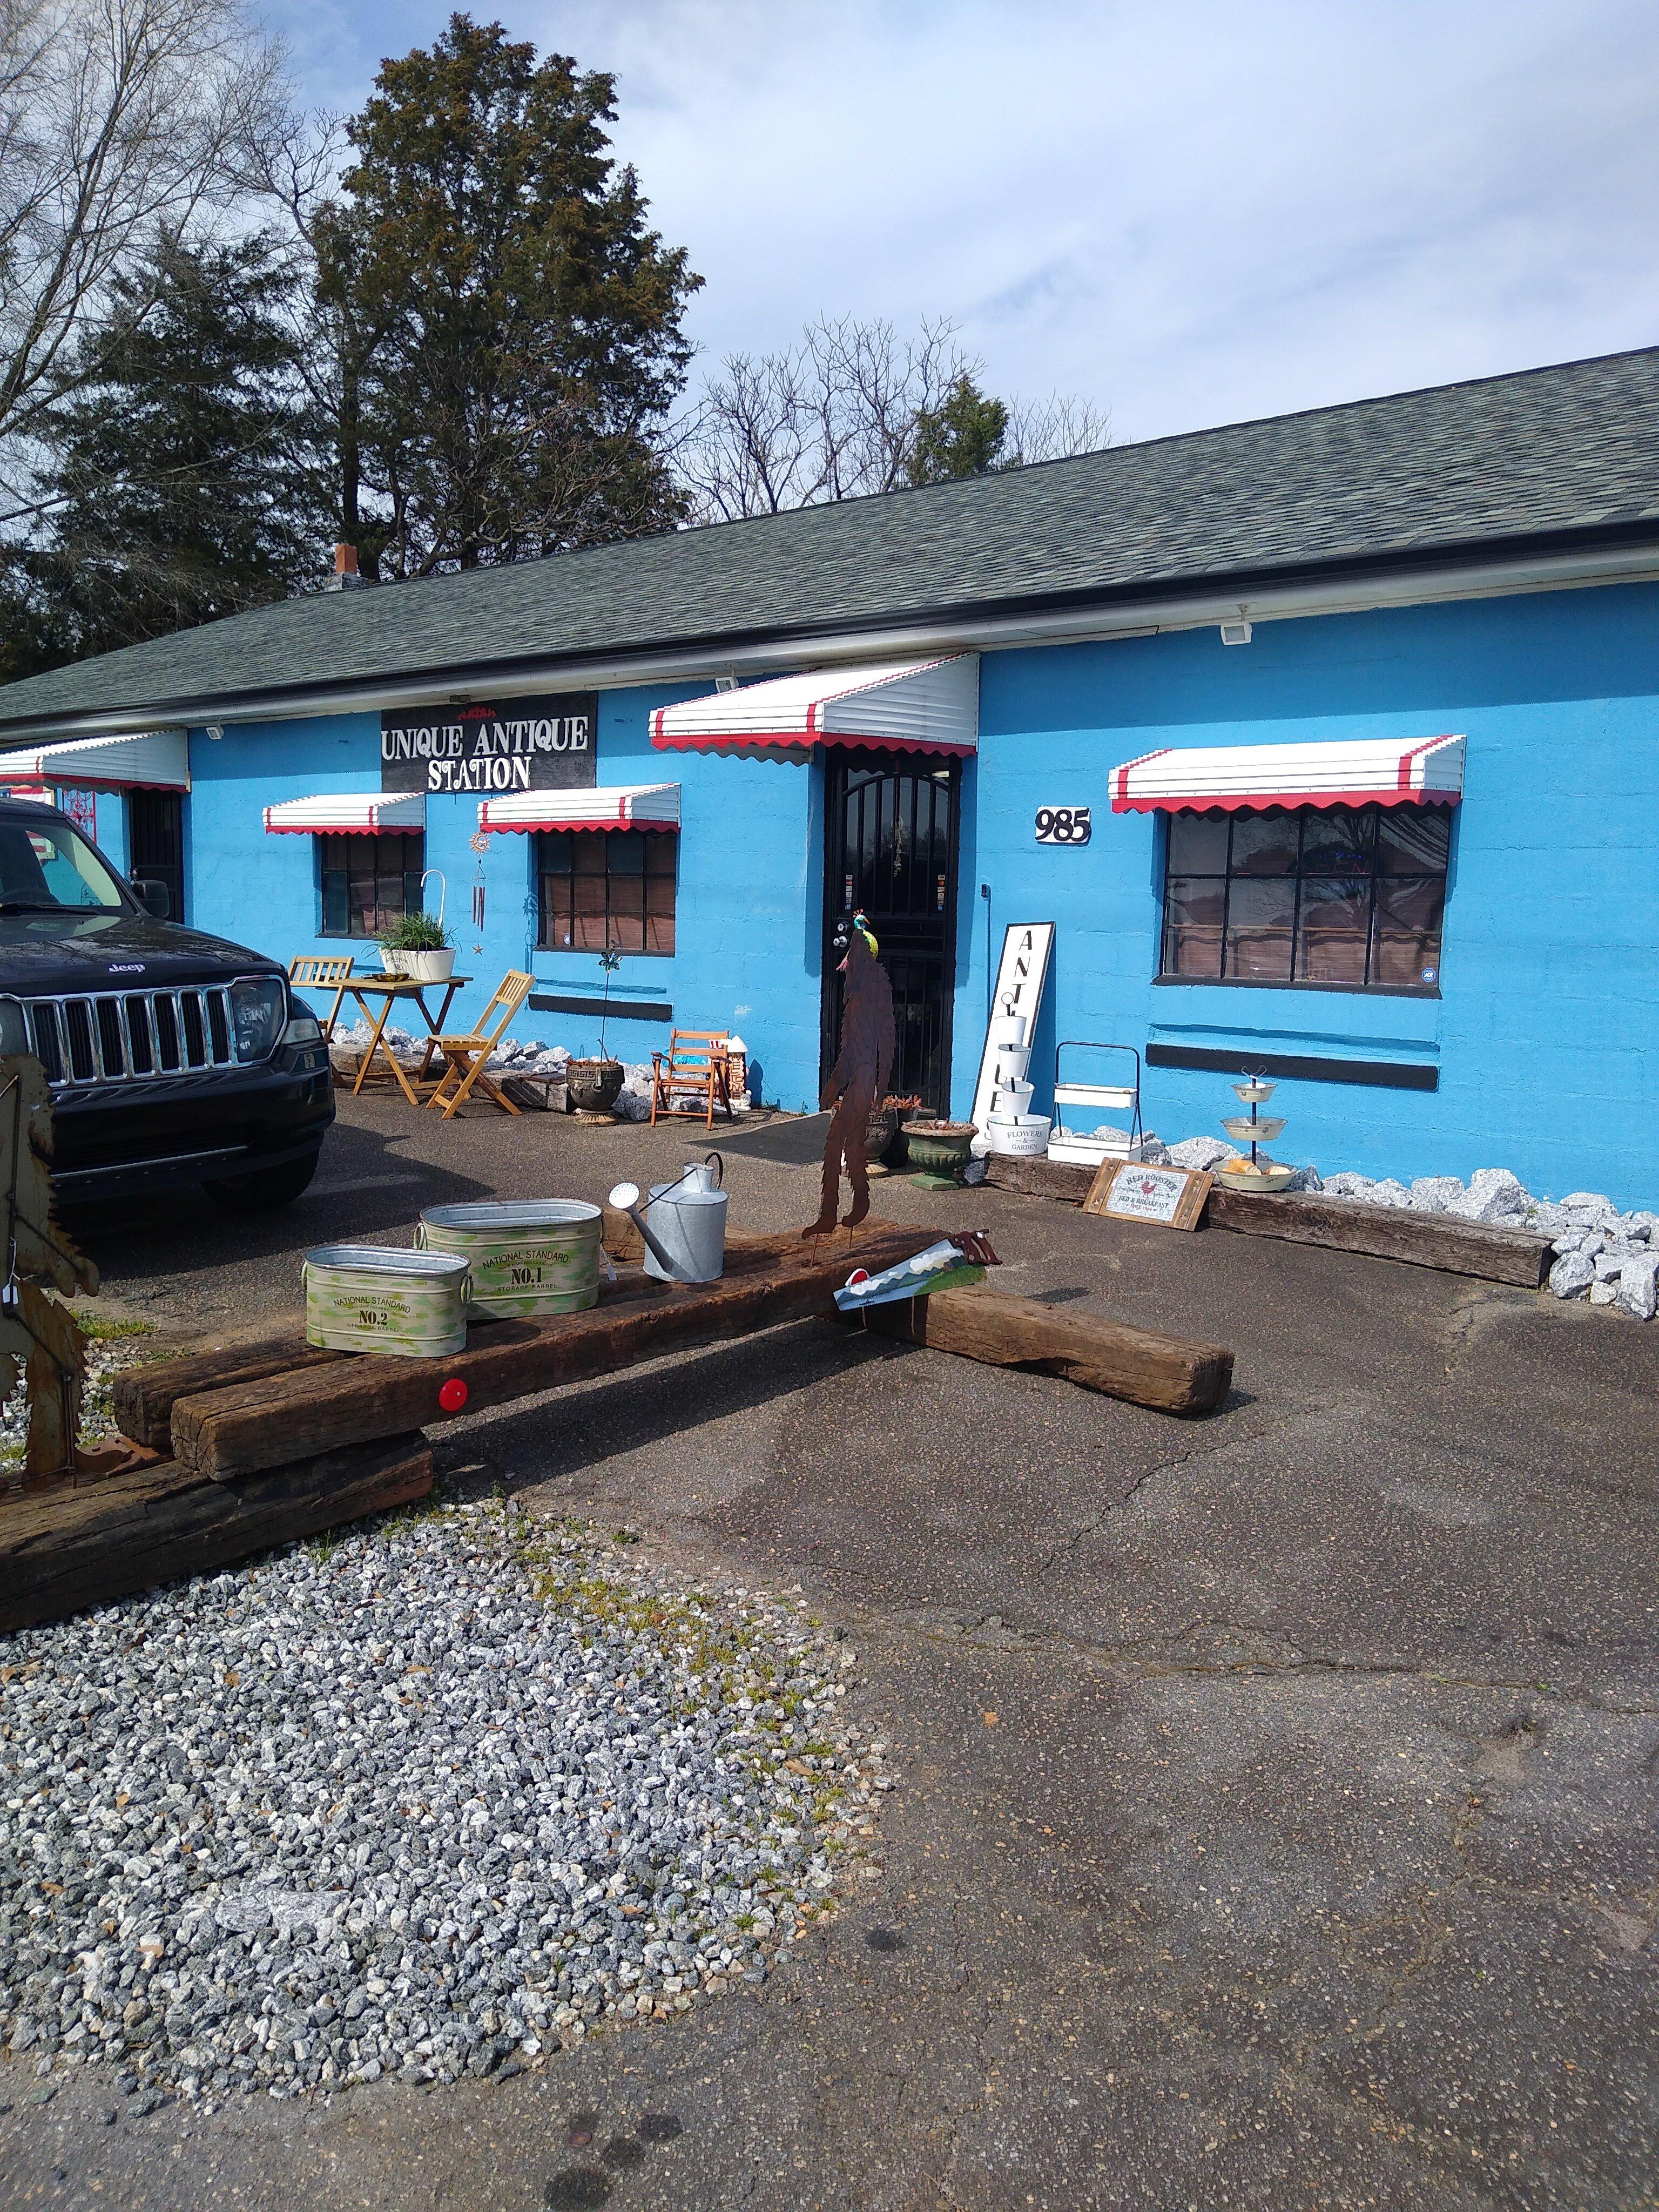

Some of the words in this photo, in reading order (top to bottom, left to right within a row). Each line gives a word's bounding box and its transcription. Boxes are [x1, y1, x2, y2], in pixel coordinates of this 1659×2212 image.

[381, 725, 463, 760] UNIQUE
[473, 716, 589, 756] ANTIQUE
[428, 757, 532, 791] STATION
[1035, 807, 1091, 842] 985
[109, 964, 146, 973] Jeep
[1007, 1130, 1043, 1139] FLOWERS
[1126, 1175, 1143, 1184] RED
[1145, 1174, 1177, 1192] ROOSTER
[1137, 1198, 1169, 1209] BREAKFAST
[482, 1251, 523, 1270] NATIONAL
[525, 1250, 569, 1263] STANDARD
[511, 1267, 542, 1285] NO.1
[333, 1296, 369, 1306] NATIONAL
[372, 1297, 411, 1313] STANDARD
[359, 1310, 388, 1326] NO.2
